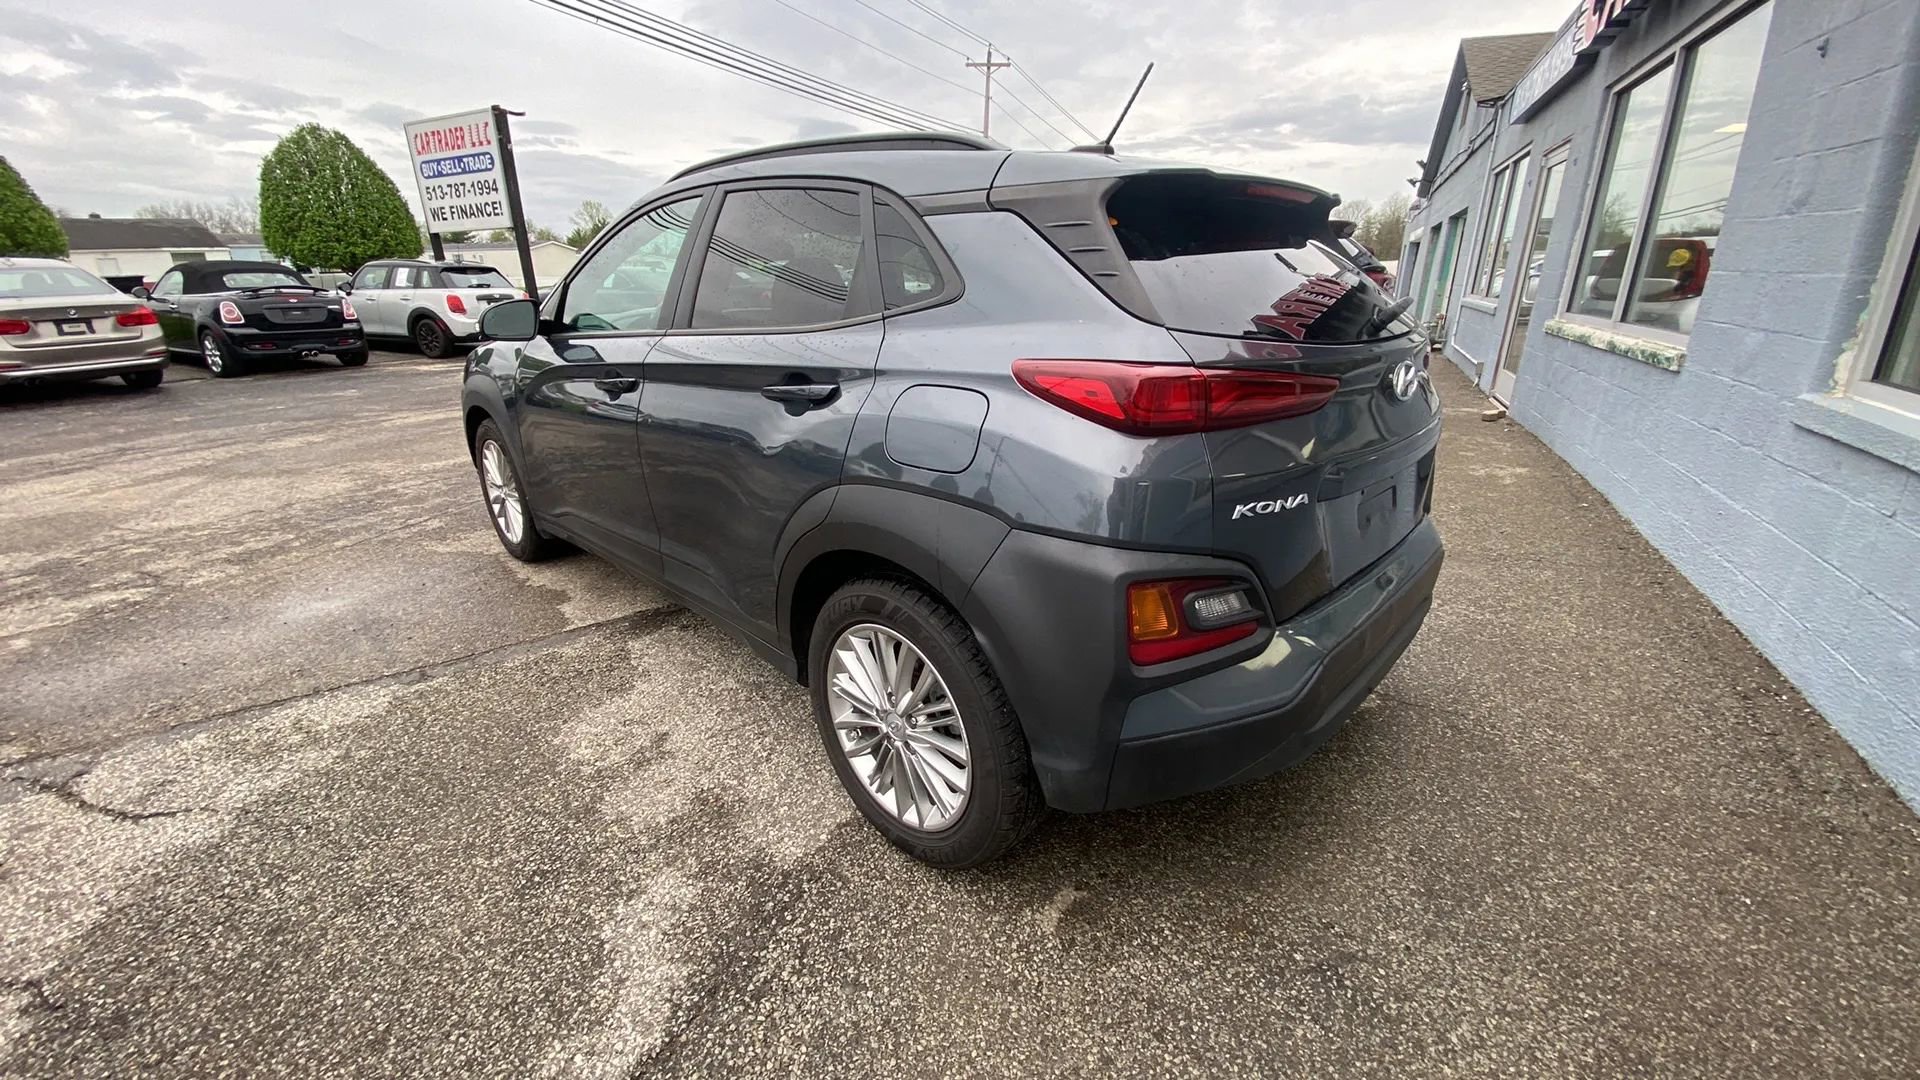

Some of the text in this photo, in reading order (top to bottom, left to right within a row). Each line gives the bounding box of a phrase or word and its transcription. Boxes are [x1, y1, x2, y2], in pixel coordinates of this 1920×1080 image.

[414, 121, 491, 156] CARTRADER LLC
[425, 178, 499, 201] 513-787-1994
[430, 201, 504, 222] WE FINANCE!
[1231, 493, 1309, 520] KONA
